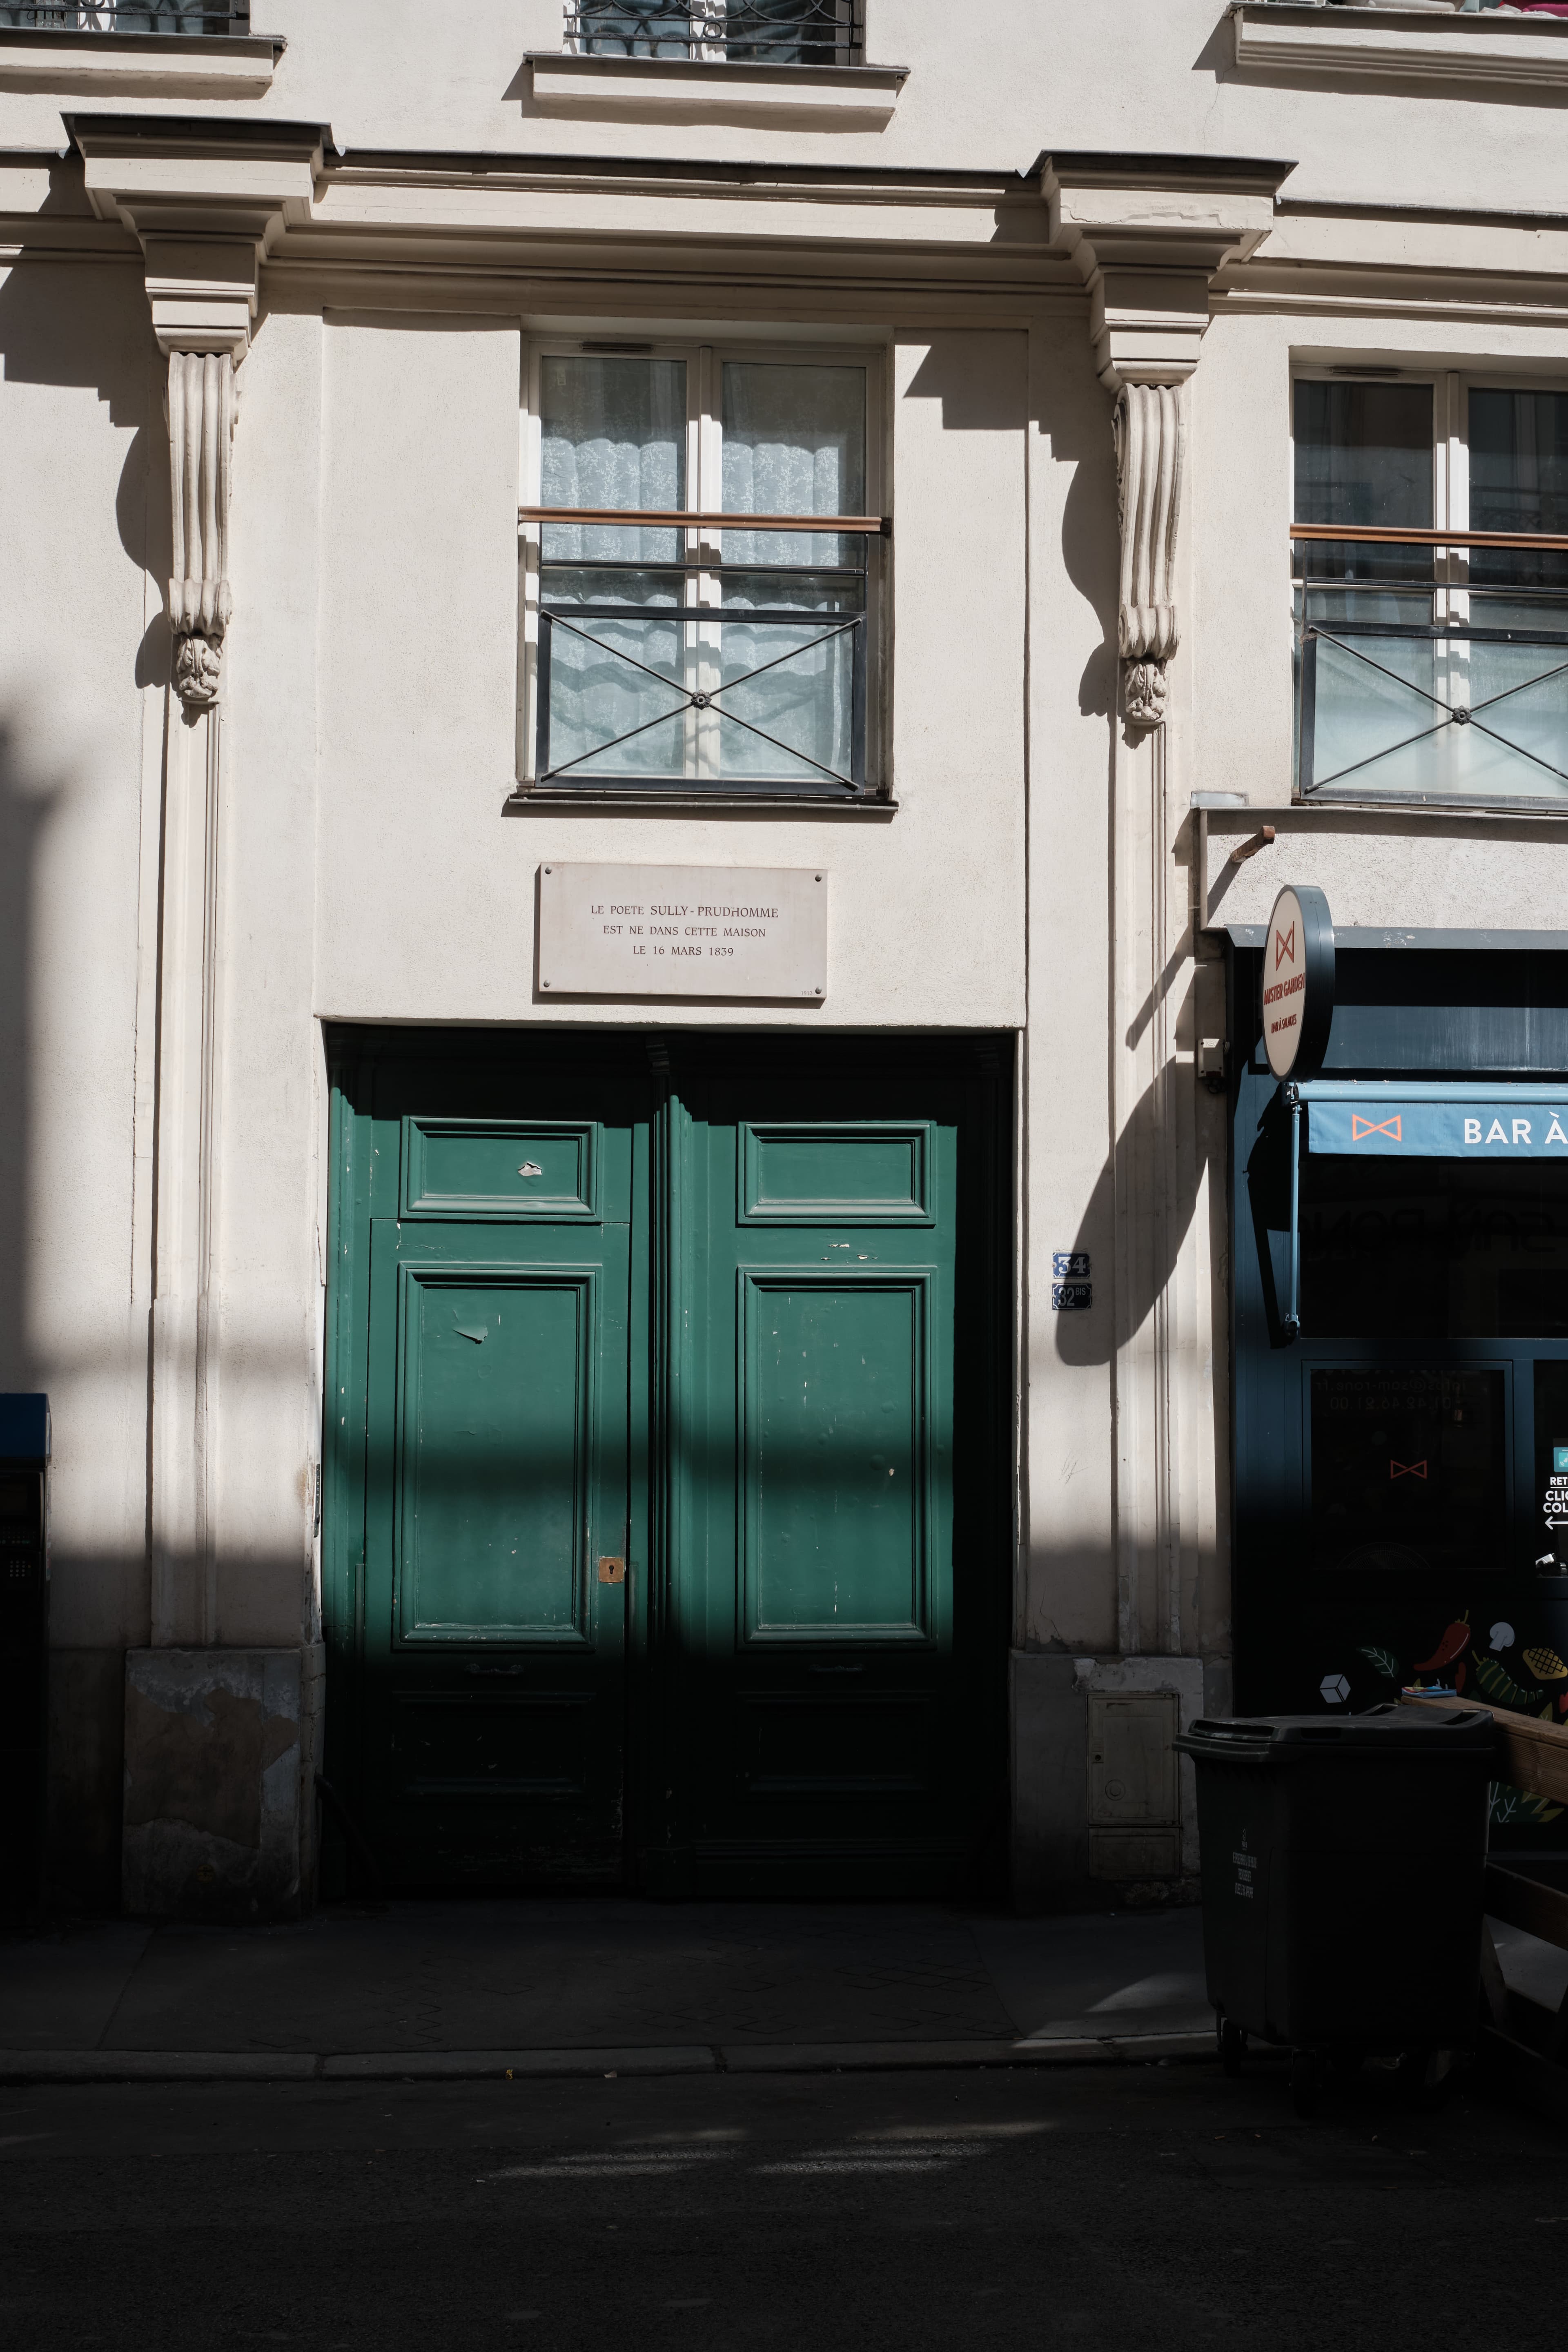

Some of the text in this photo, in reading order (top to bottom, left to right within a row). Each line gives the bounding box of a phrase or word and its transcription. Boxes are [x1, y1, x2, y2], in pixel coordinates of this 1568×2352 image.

[591, 905, 604, 914] LE
[610, 906, 644, 915] POETE
[603, 925, 766, 938] EST NE DANS CETTE MAISON
[633, 945, 734, 956] LE 16 MARS 1839
[1264, 973, 1305, 1005] MISTER GARDEN
[1278, 1017, 1282, 1031] À
[1282, 1013, 1297, 1029] SALADES
[1463, 1111, 1568, 1144] BAR À
[1058, 1256, 1086, 1274] 34
[1058, 1287, 1086, 1307] 32 BIS
